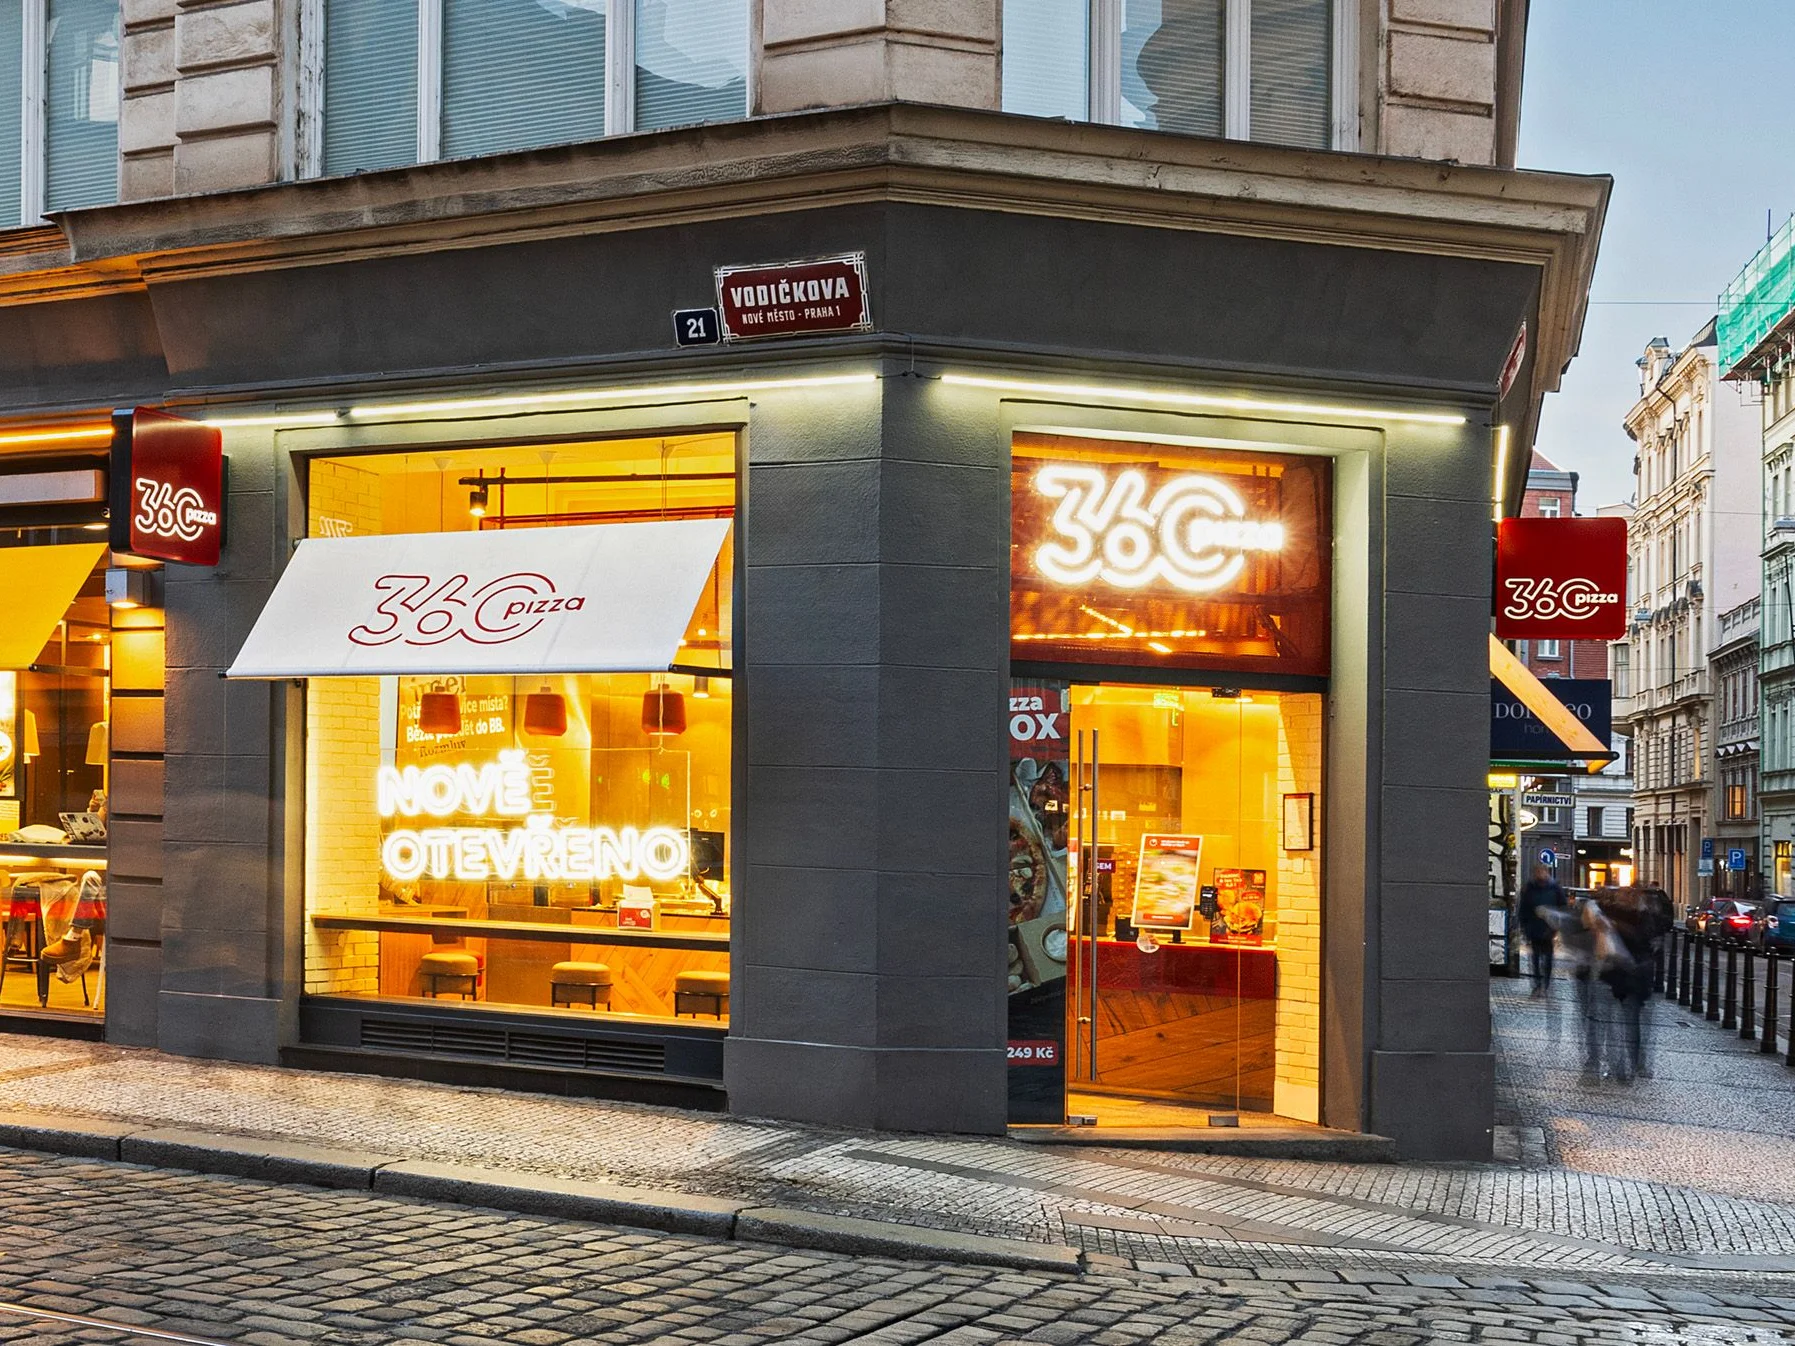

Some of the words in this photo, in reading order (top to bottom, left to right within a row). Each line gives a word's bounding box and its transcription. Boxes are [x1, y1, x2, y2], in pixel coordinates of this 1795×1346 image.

[730, 277, 850, 308] VODIČKOVA
[742, 310, 764, 325] NOVÉ
[767, 308, 795, 323] MĚSTO
[804, 306, 834, 320] PRAHA
[837, 305, 841, 317] 1
[686, 317, 706, 339] 21
[503, 596, 586, 621] pizza
[1575, 592, 1619, 607] pizza
[1009, 696, 1043, 711] zza
[476, 718, 488, 734] do
[1009, 713, 1061, 741] OX
[1526, 794, 1572, 805] PAPÍRNICTVÍ
[383, 814, 690, 881] OTEVŘENO
[1732, 850, 1742, 863] P
[1007, 1047, 1032, 1059] 249
[1036, 1046, 1054, 1059] Kč
